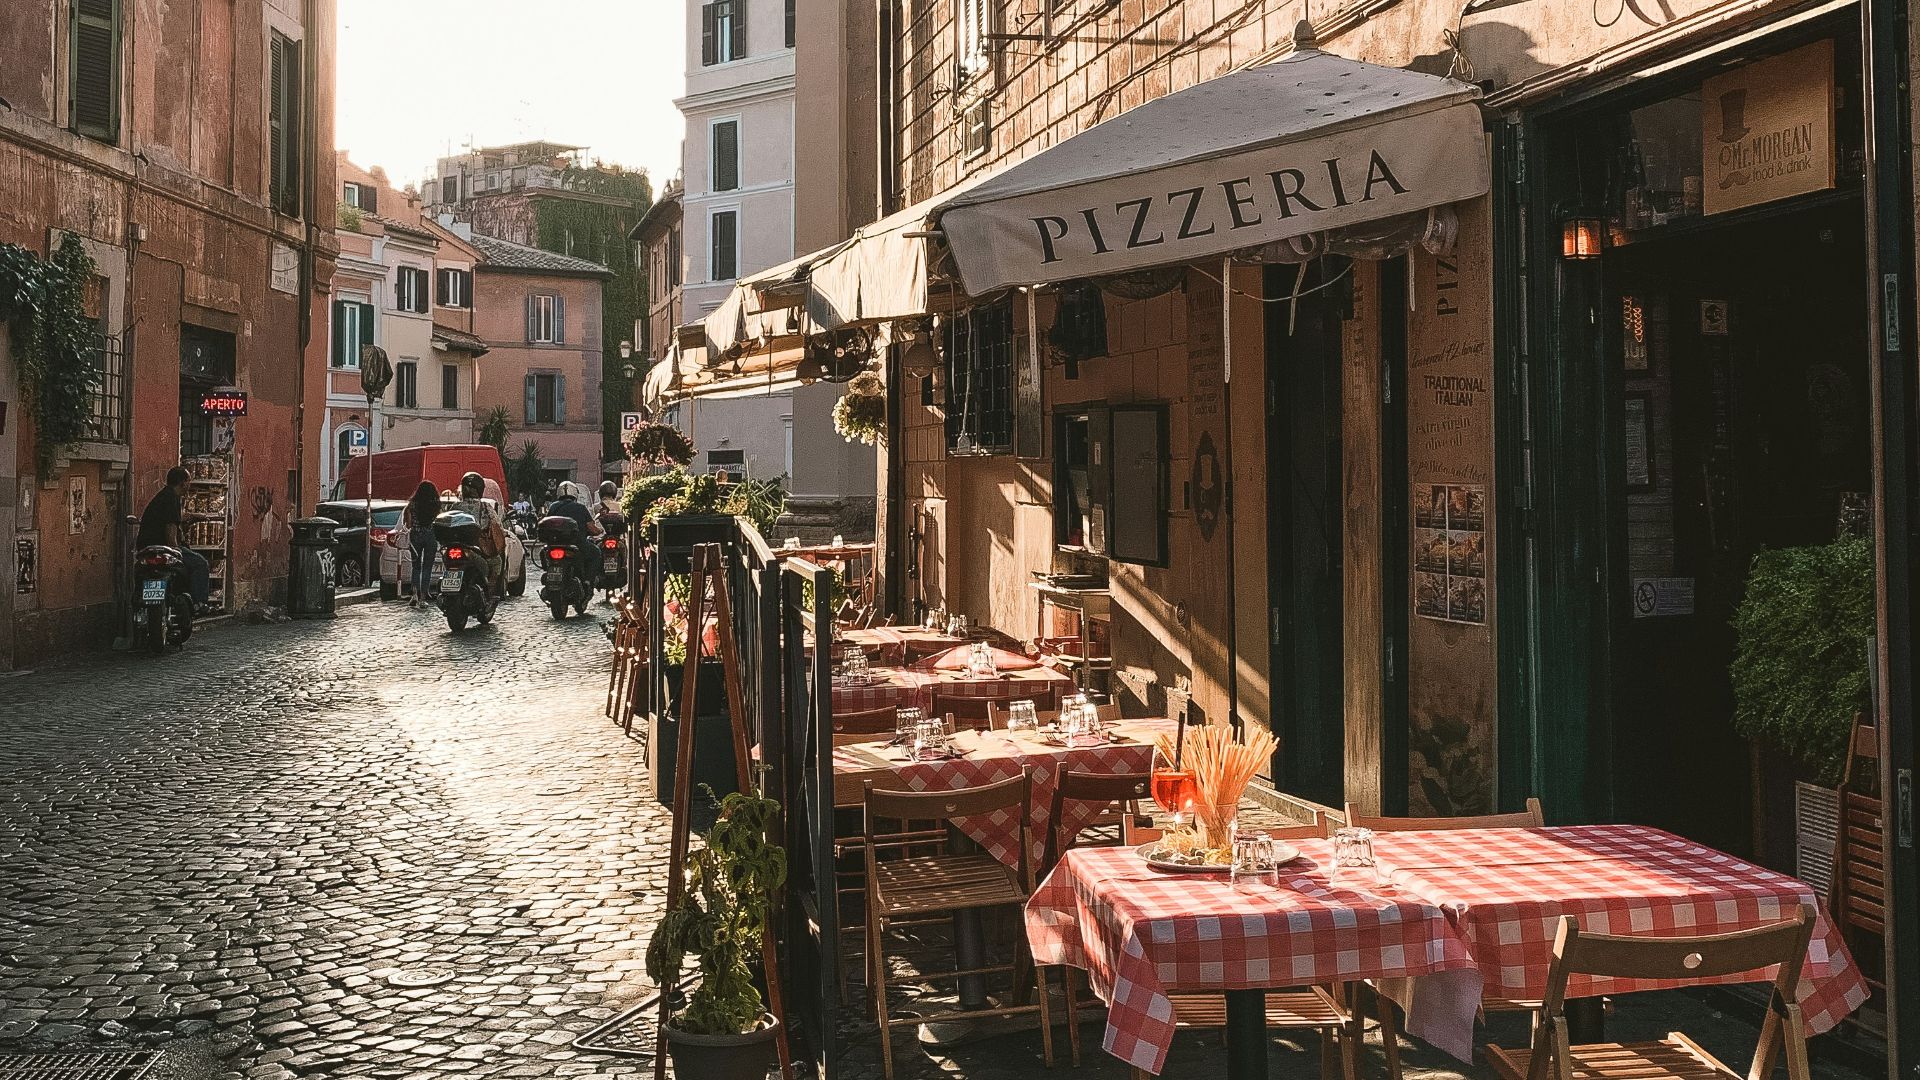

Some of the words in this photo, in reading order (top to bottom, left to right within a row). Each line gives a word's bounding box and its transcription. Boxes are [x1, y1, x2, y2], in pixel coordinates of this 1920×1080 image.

[1753, 165, 1773, 182] food
[1776, 162, 1785, 177] &
[1786, 155, 1811, 174] drink
[1028, 148, 1411, 264] PIZZERIA
[1423, 374, 1487, 393] TRADITIONAL
[203, 398, 246, 410] APERTO
[1435, 391, 1473, 407] ITALIAN
[626, 416, 636, 429] P
[353, 430, 365, 445] P
